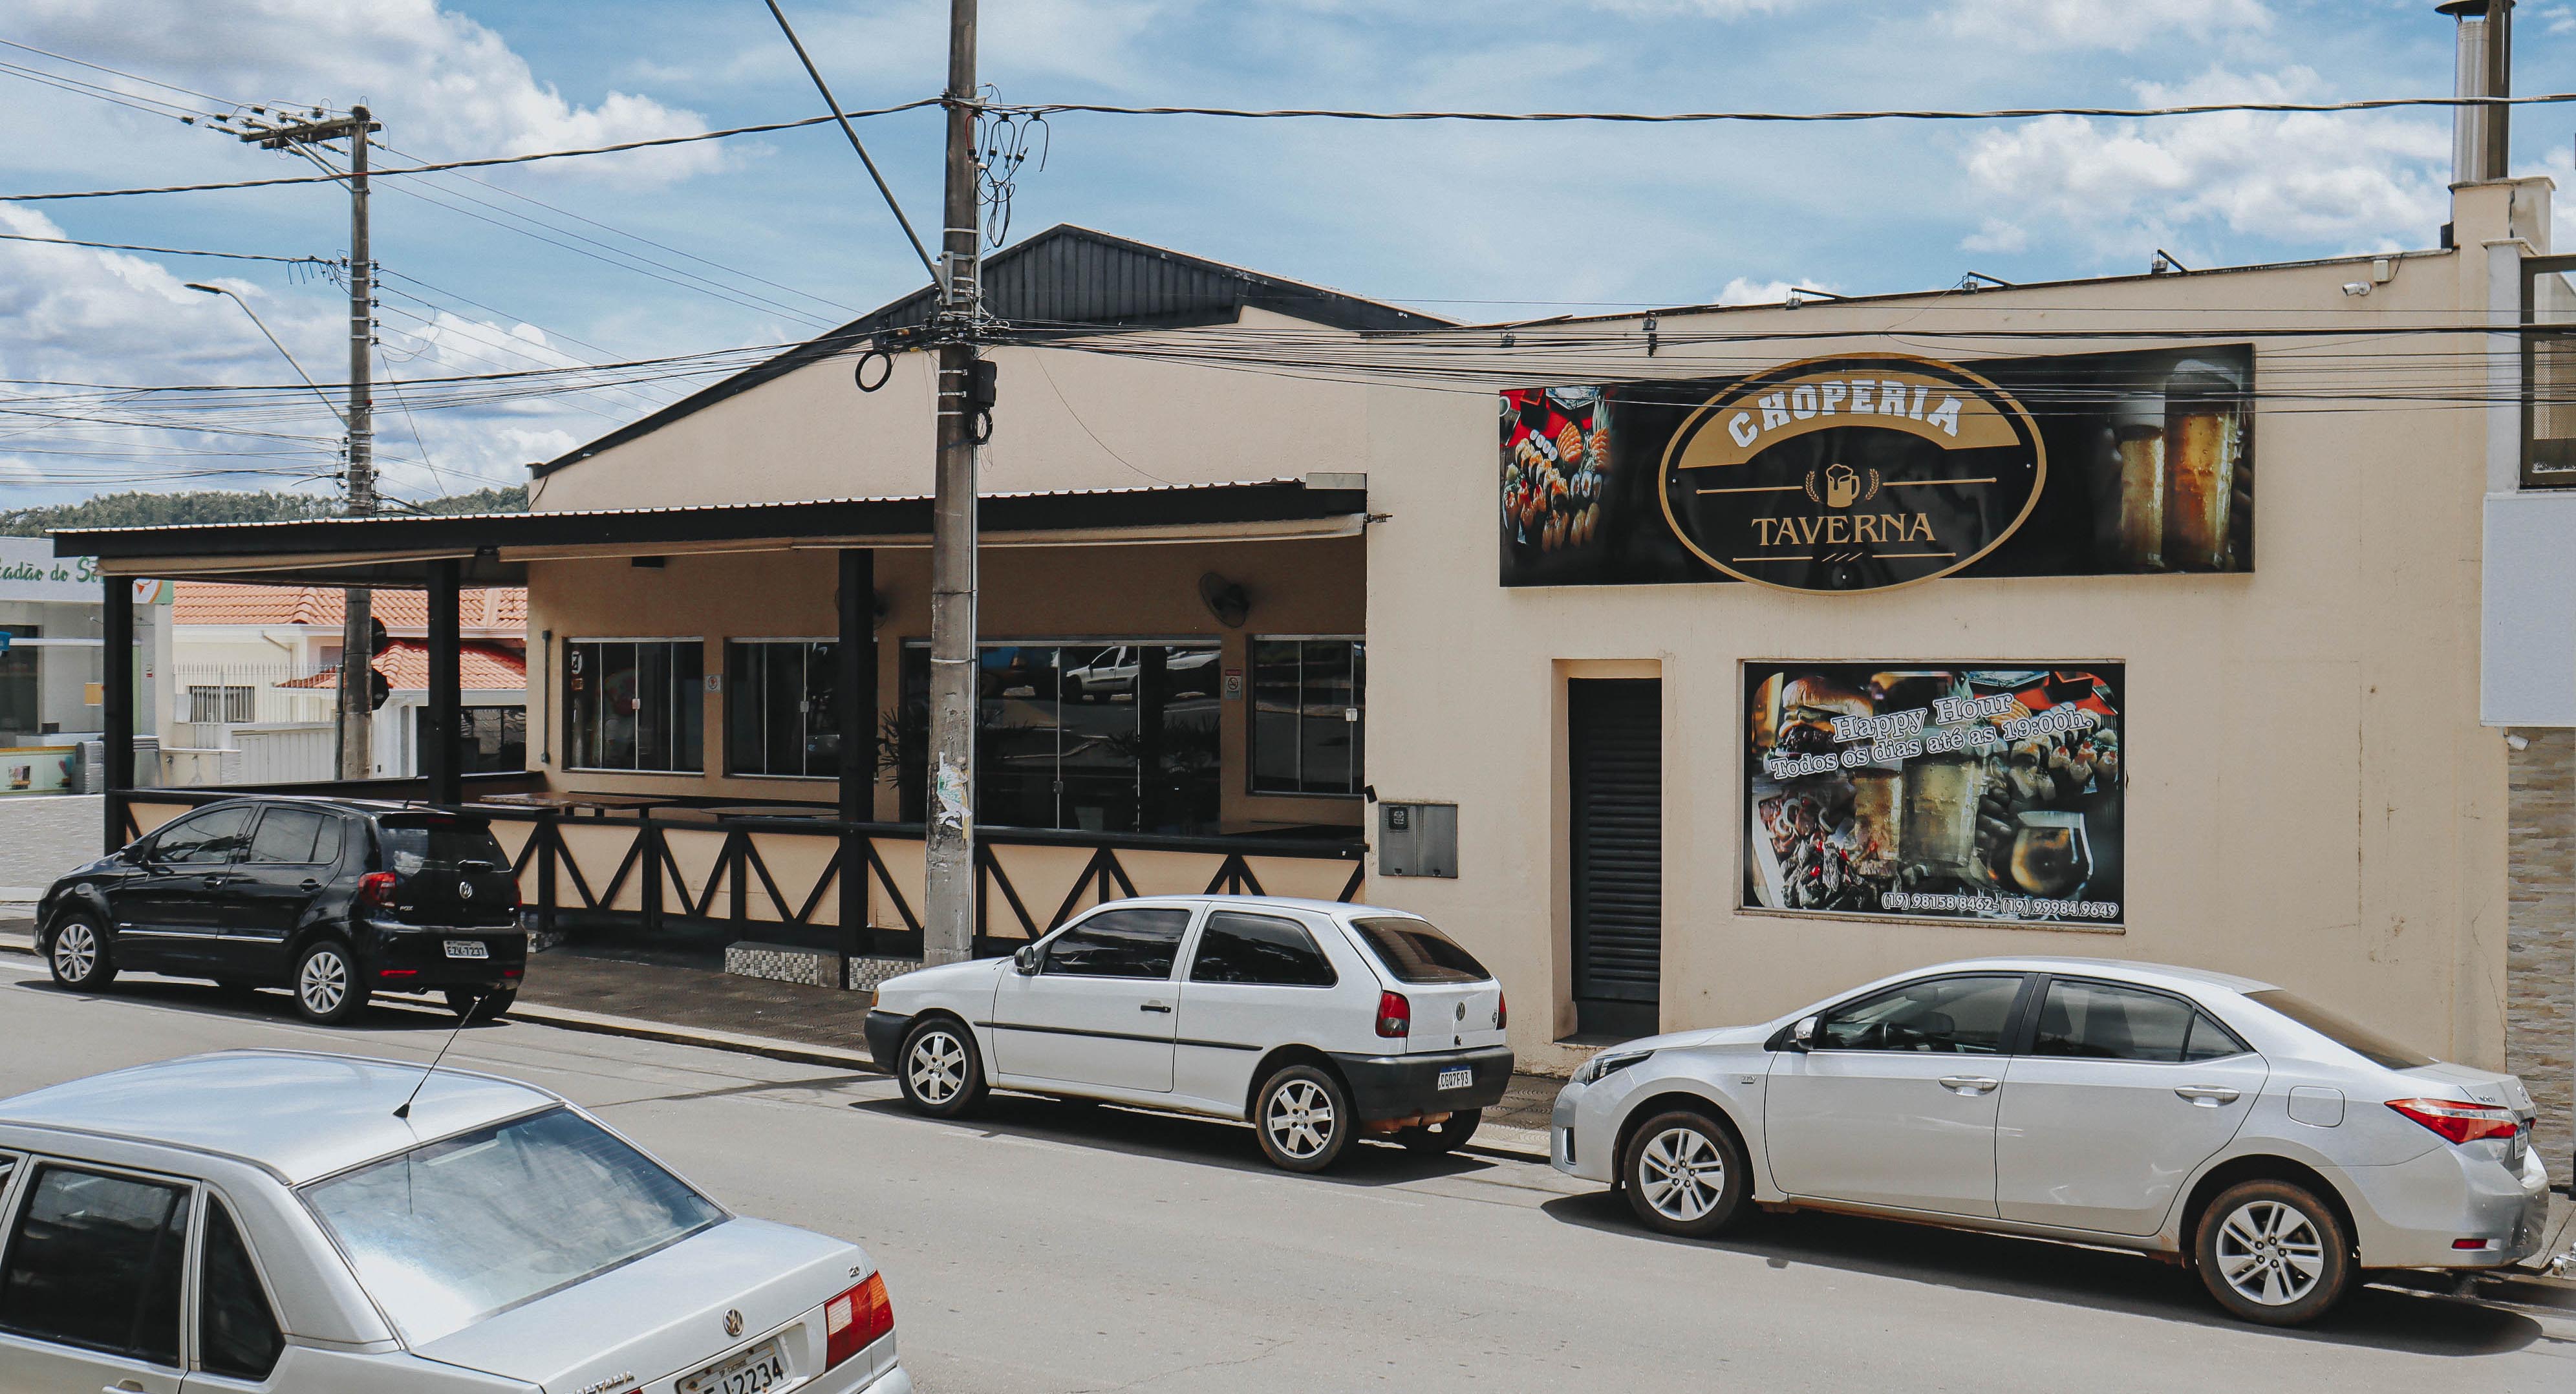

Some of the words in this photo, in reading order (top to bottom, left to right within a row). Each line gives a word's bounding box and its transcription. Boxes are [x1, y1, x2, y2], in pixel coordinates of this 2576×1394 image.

[1728, 379, 1962, 447] CHOPERIA
[1751, 513, 1936, 546] TAVERNA
[0, 560, 45, 581] adão
[50, 563, 69, 582] do
[1831, 708, 1927, 742] Happy
[1933, 694, 2015, 725] Hour
[1770, 753, 1838, 780] Todos
[1841, 747, 1869, 768] os
[1872, 739, 1922, 763] dias
[1927, 727, 1964, 755] até
[1969, 725, 1997, 746] as
[2002, 709, 2093, 740] 19:00h.
[1881, 892, 1910, 910] (19)
[1911, 893, 1956, 910] 98158
[2001, 898, 2030, 917] (19)
[2031, 899, 2079, 916] 99984
[2079, 901, 2119, 918] 9649
